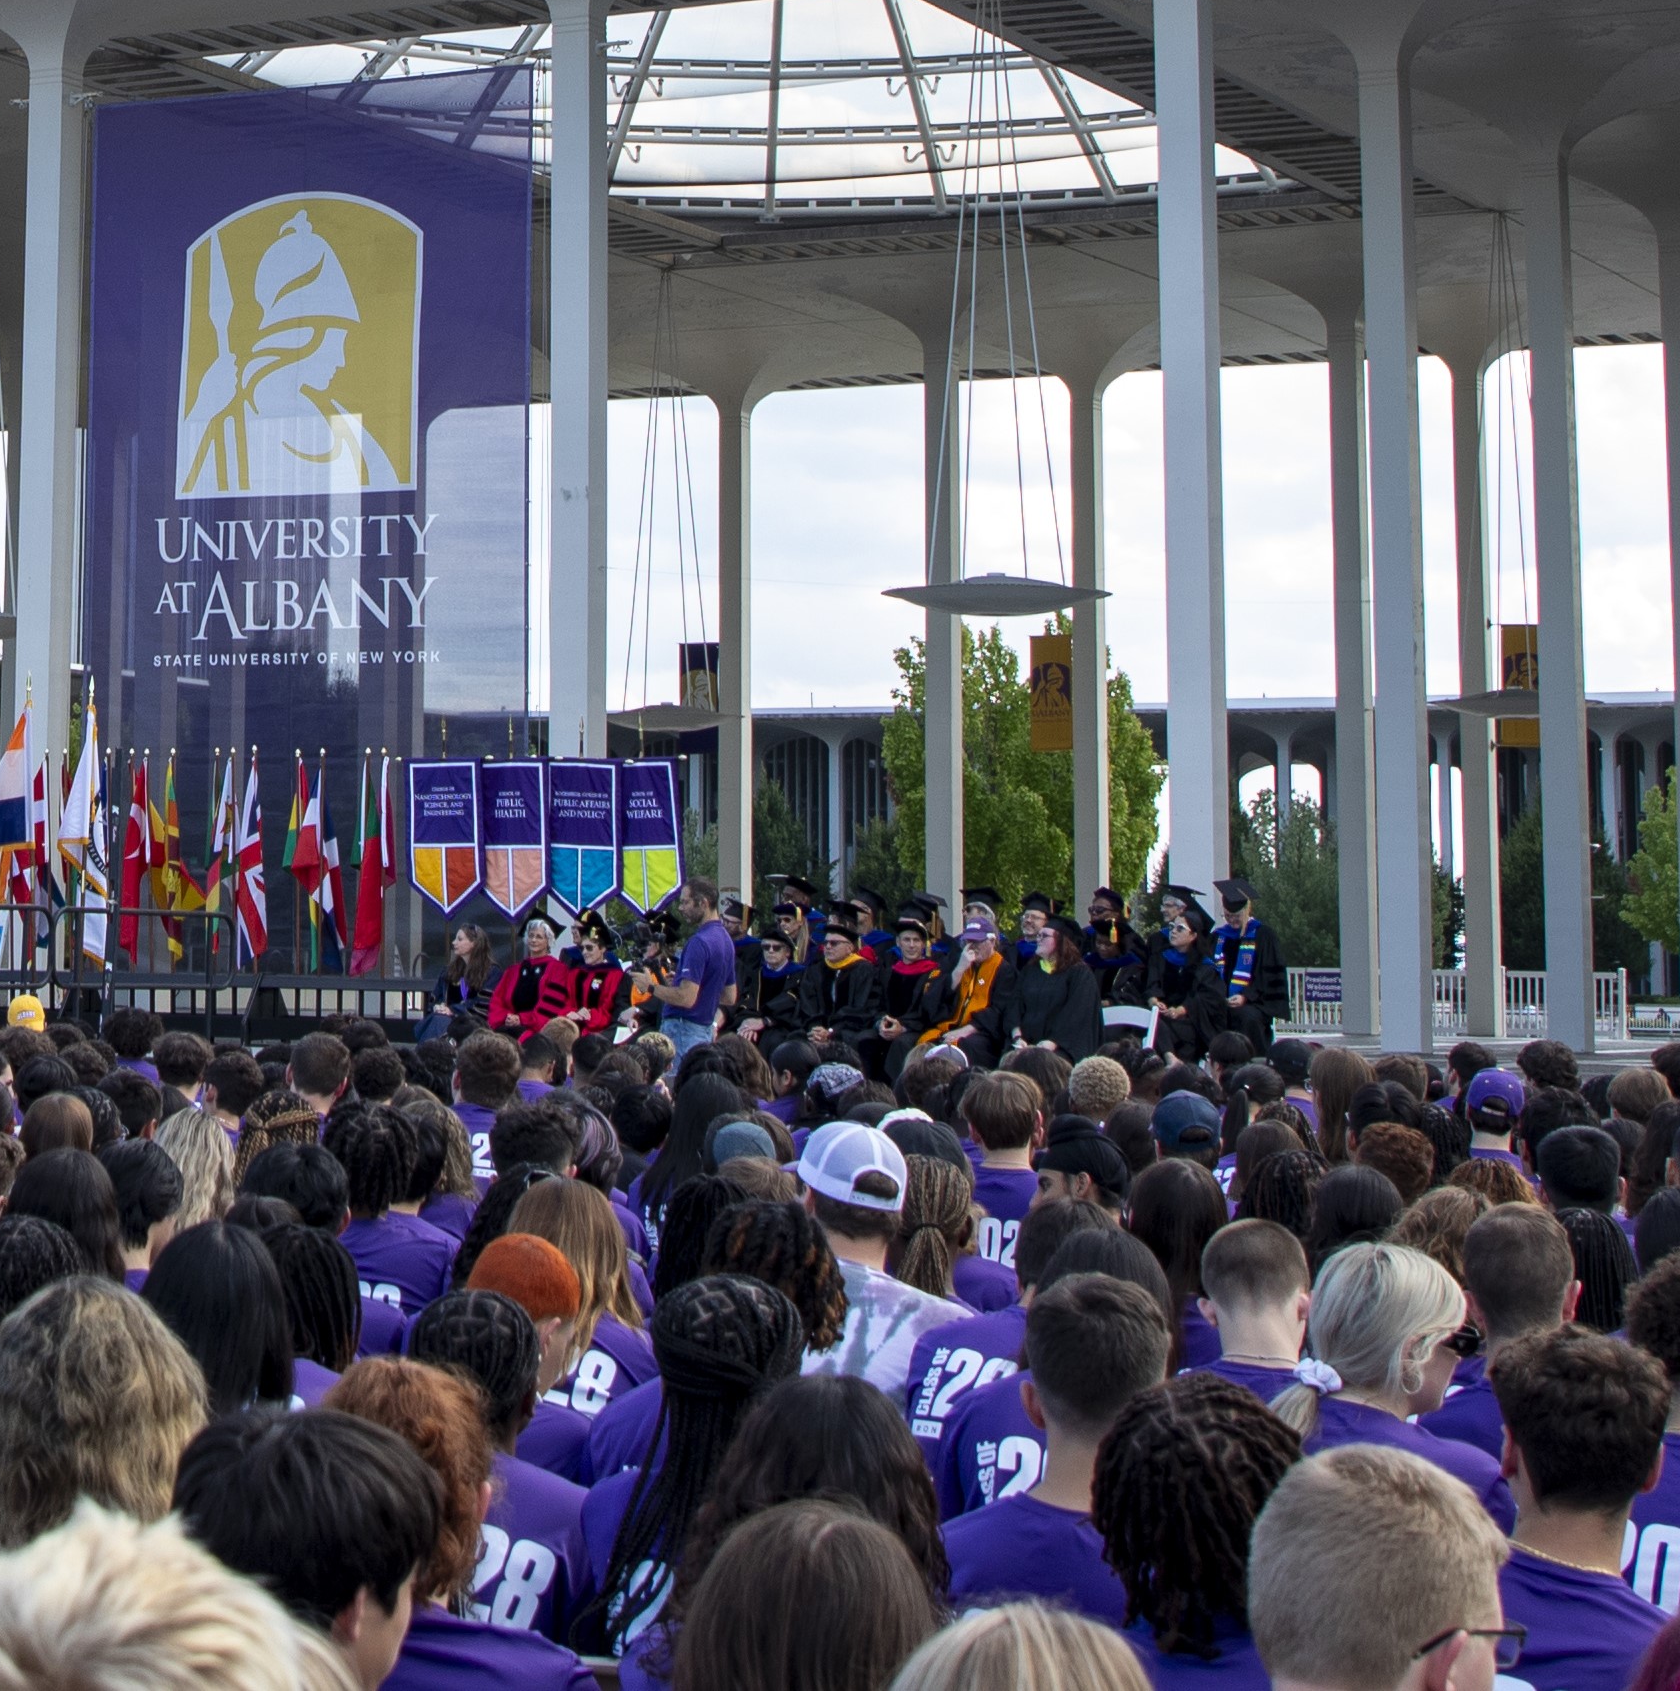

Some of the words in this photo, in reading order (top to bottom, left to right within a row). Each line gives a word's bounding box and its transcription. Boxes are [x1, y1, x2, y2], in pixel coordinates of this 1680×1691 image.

[155, 513, 440, 563] UNIVERSITY
[153, 581, 196, 615] AT
[191, 570, 439, 640] ALBANY
[153, 654, 202, 667] STATE
[209, 652, 312, 666] UNIVERSITY
[317, 652, 341, 665] OF
[346, 651, 385, 664] NEW
[392, 650, 441, 663] YORK
[496, 798, 525, 807] PUBLIC
[553, 798, 580, 807] PUBLIC
[579, 799, 611, 809] AFFAIRS
[629, 798, 658, 807] SOCIAL
[559, 809, 576, 817] AND
[577, 810, 606, 819] POLICY
[626, 809, 663, 819] WELFARE
[915, 1366, 942, 1417] CLASS
[931, 1347, 951, 1365] OF
